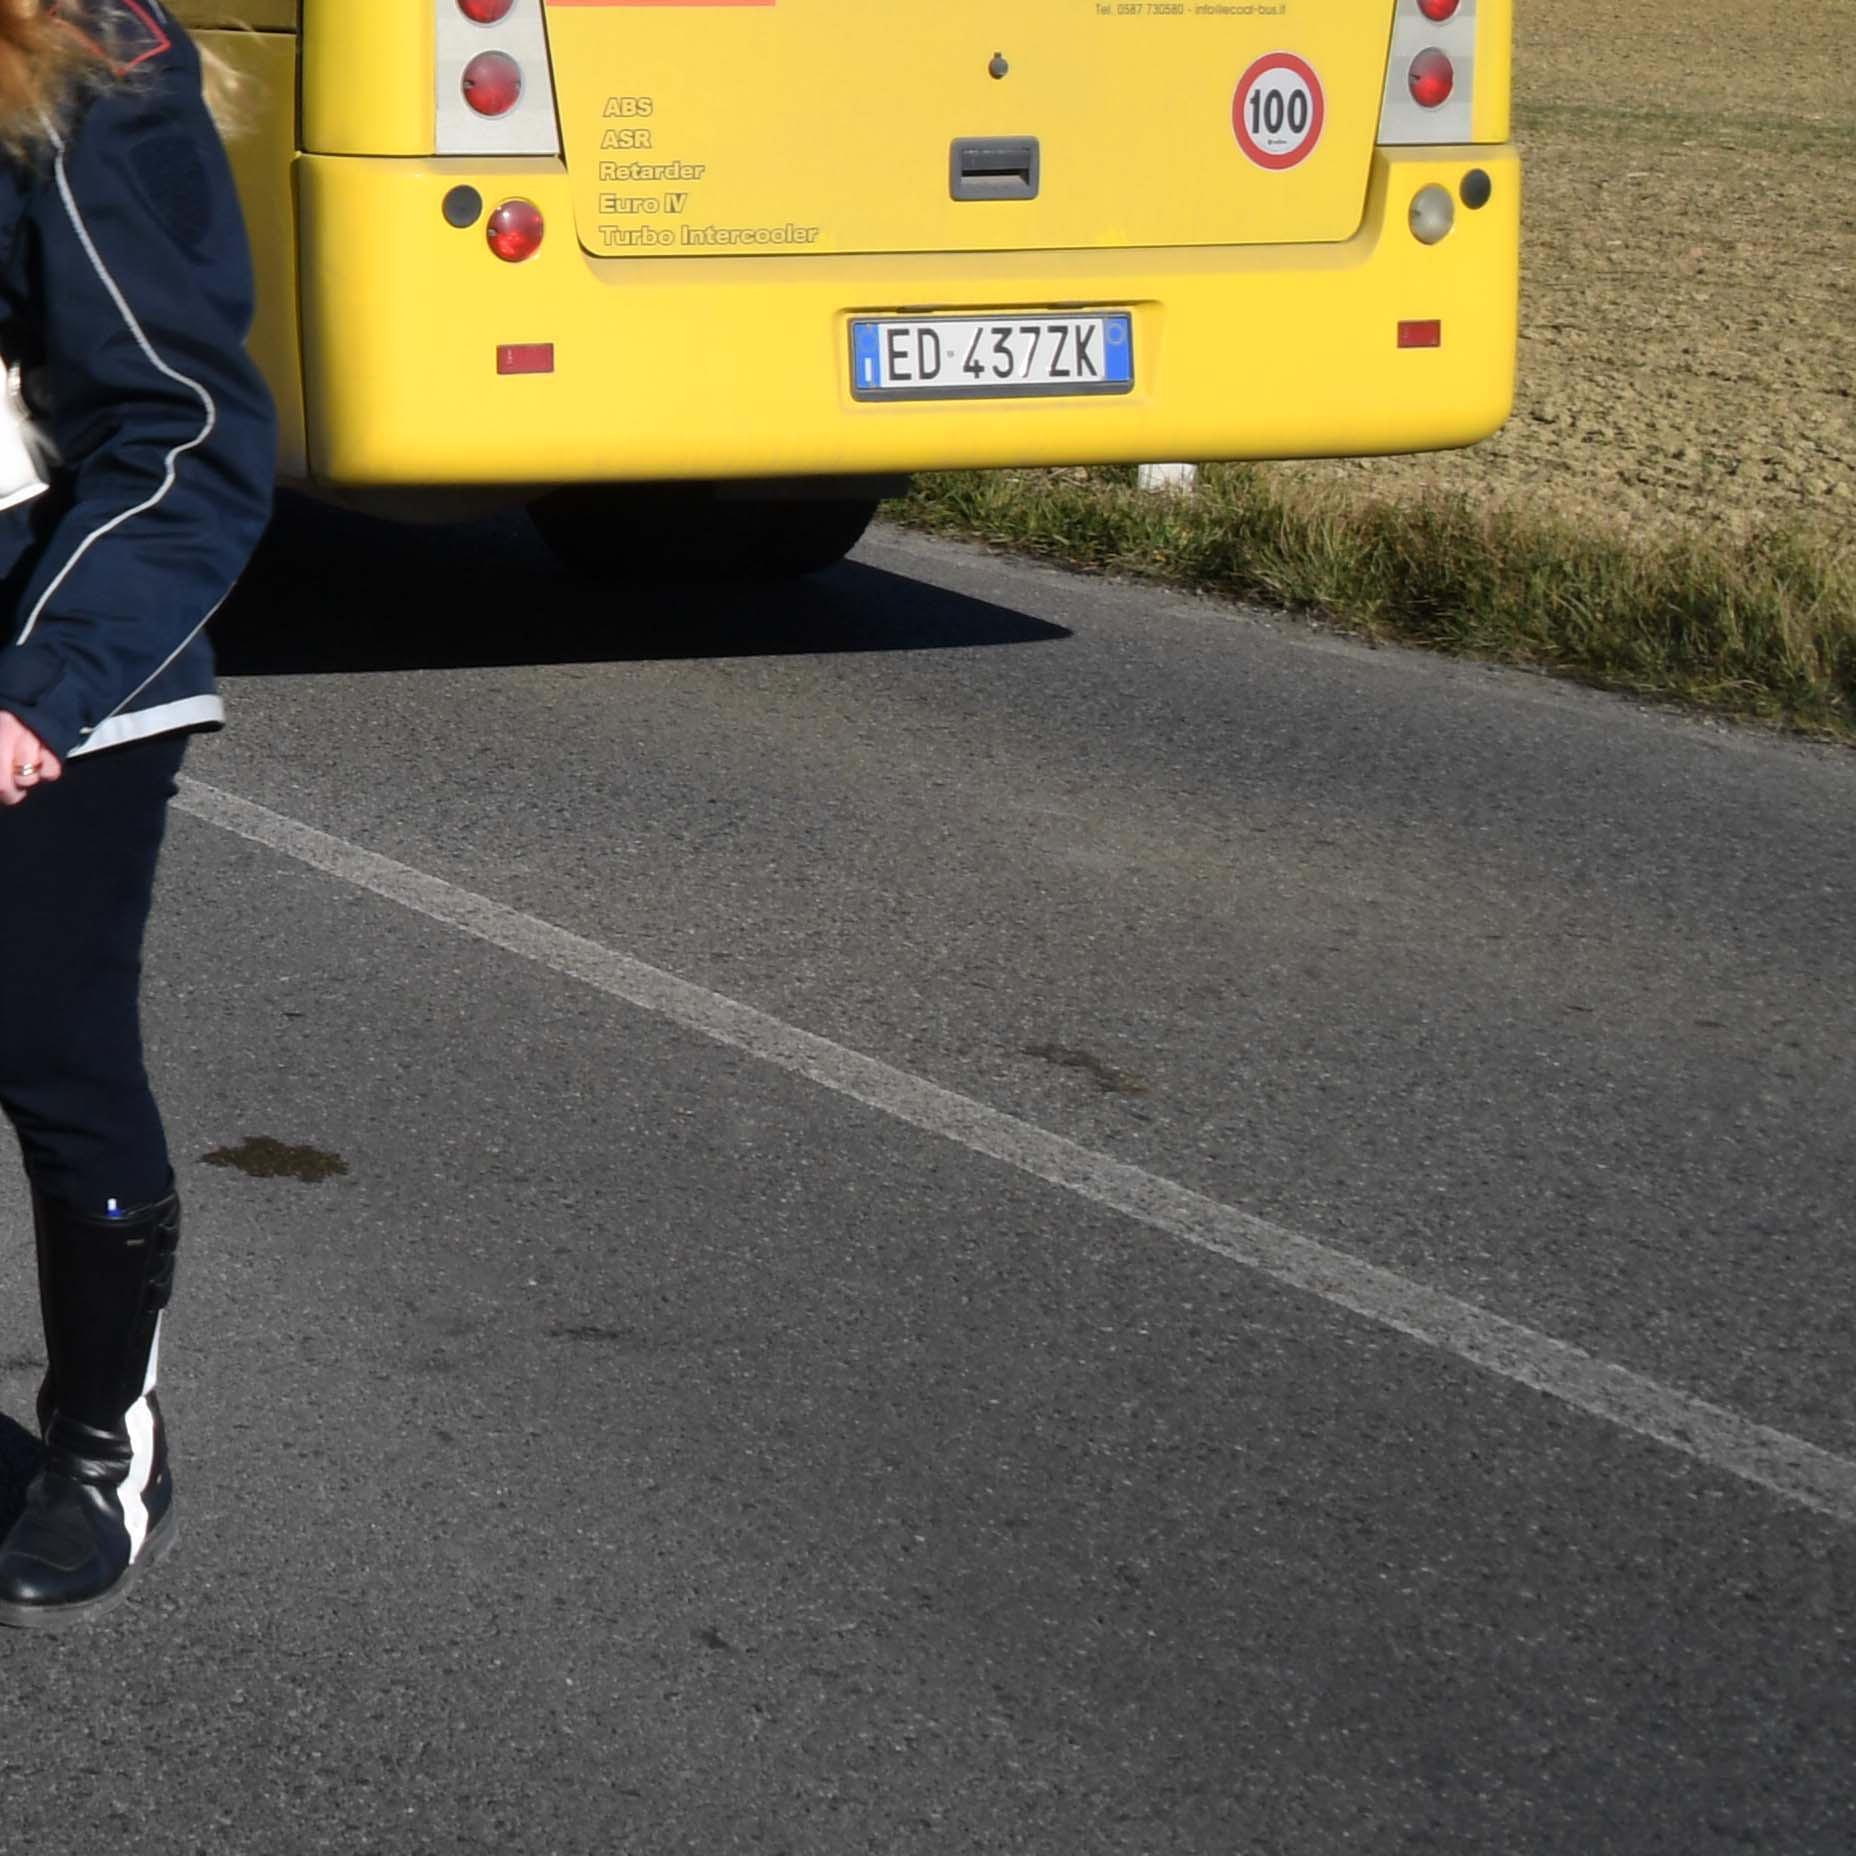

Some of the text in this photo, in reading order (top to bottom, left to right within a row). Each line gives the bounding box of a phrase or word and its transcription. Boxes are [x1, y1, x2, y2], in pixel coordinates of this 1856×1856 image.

[602, 97, 654, 118] ABS
[1249, 88, 1308, 134] 100
[600, 129, 652, 150] ASR
[599, 160, 705, 181] Retarder
[599, 193, 659, 214] Euro
[598, 222, 819, 247] Turbo Intercooler
[887, 324, 1098, 381] ED 437ZK
